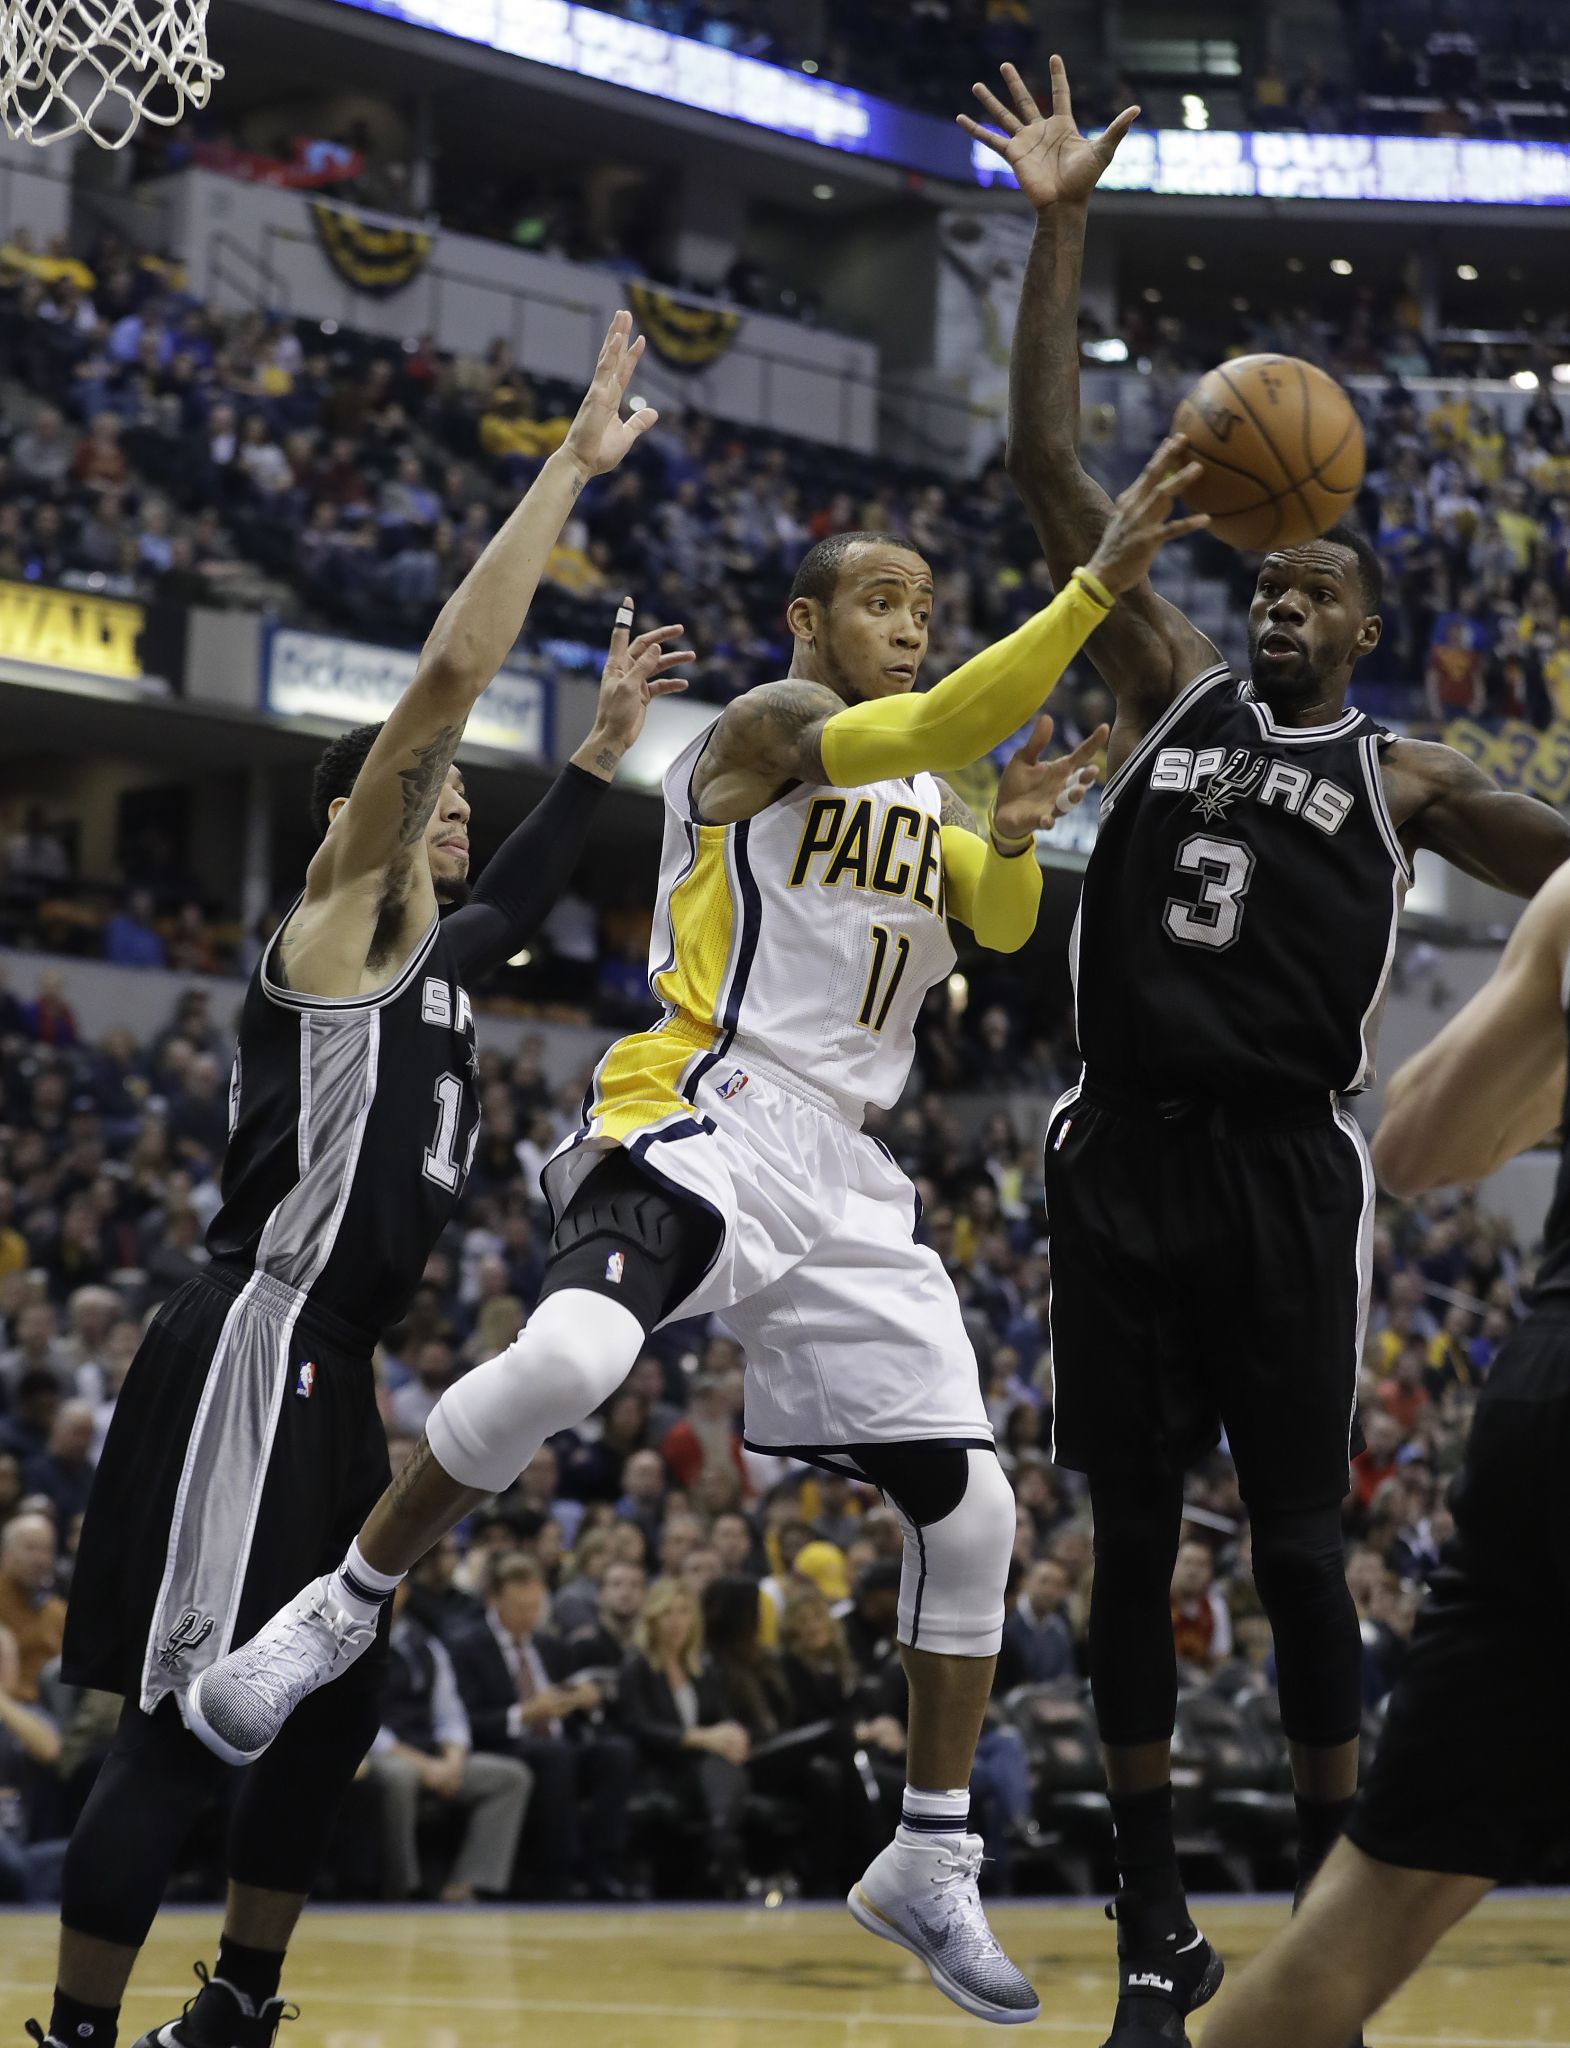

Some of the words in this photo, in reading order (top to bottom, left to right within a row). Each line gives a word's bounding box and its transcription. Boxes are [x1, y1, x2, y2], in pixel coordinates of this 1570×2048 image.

[1150, 747, 1355, 836] SPURS
[786, 796, 948, 923] PACE
[1161, 832, 1257, 953] 3
[855, 922, 910, 1035] 11
